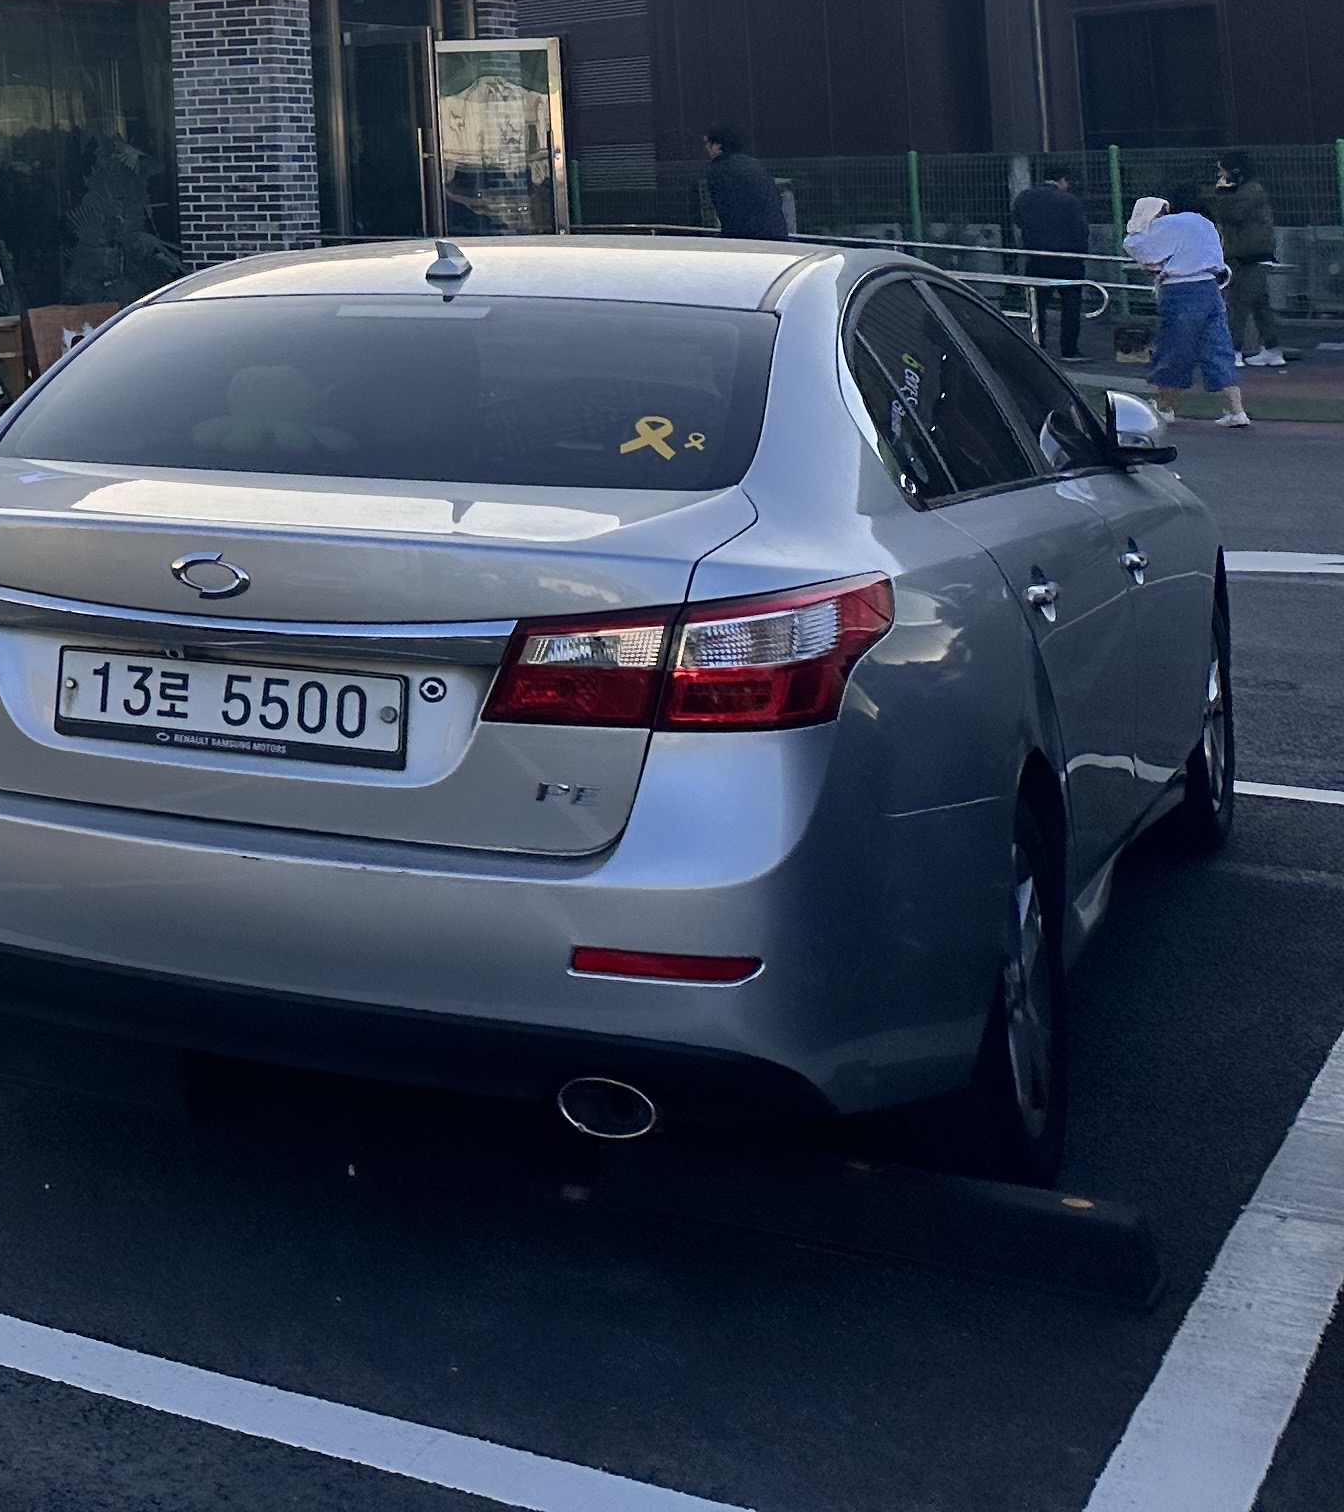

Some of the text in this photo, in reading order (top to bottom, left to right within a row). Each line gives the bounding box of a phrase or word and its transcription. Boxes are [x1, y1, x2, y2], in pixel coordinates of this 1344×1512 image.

[93, 661, 367, 739] 13로 5500
[174, 734, 287, 754] RENAULT SAMSUNG MOTORS
